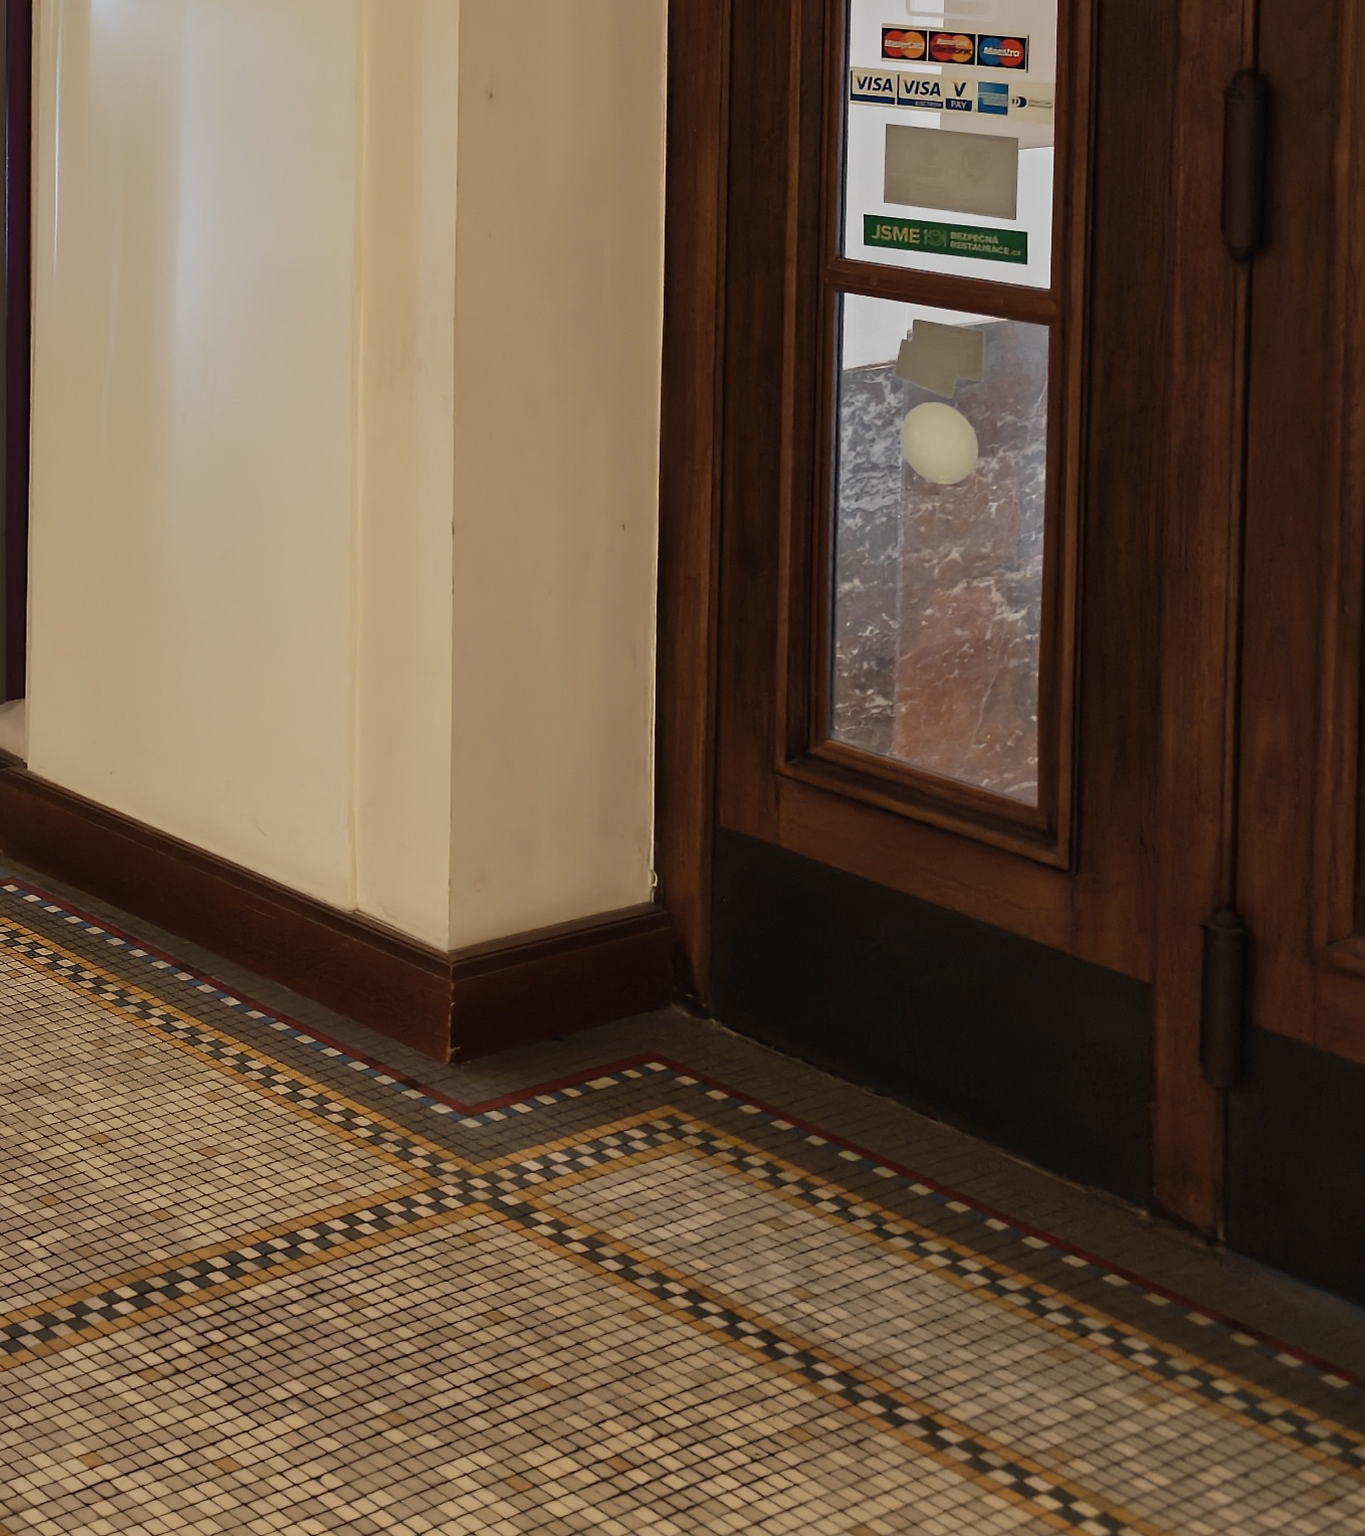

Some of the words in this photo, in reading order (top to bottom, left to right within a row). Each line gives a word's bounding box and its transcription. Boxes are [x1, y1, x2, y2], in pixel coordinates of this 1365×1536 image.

[856, 76, 894, 93] VISA
[902, 79, 942, 97] VISA
[952, 81, 967, 97] V
[950, 100, 967, 110] PAY
[871, 224, 921, 244] JSME
